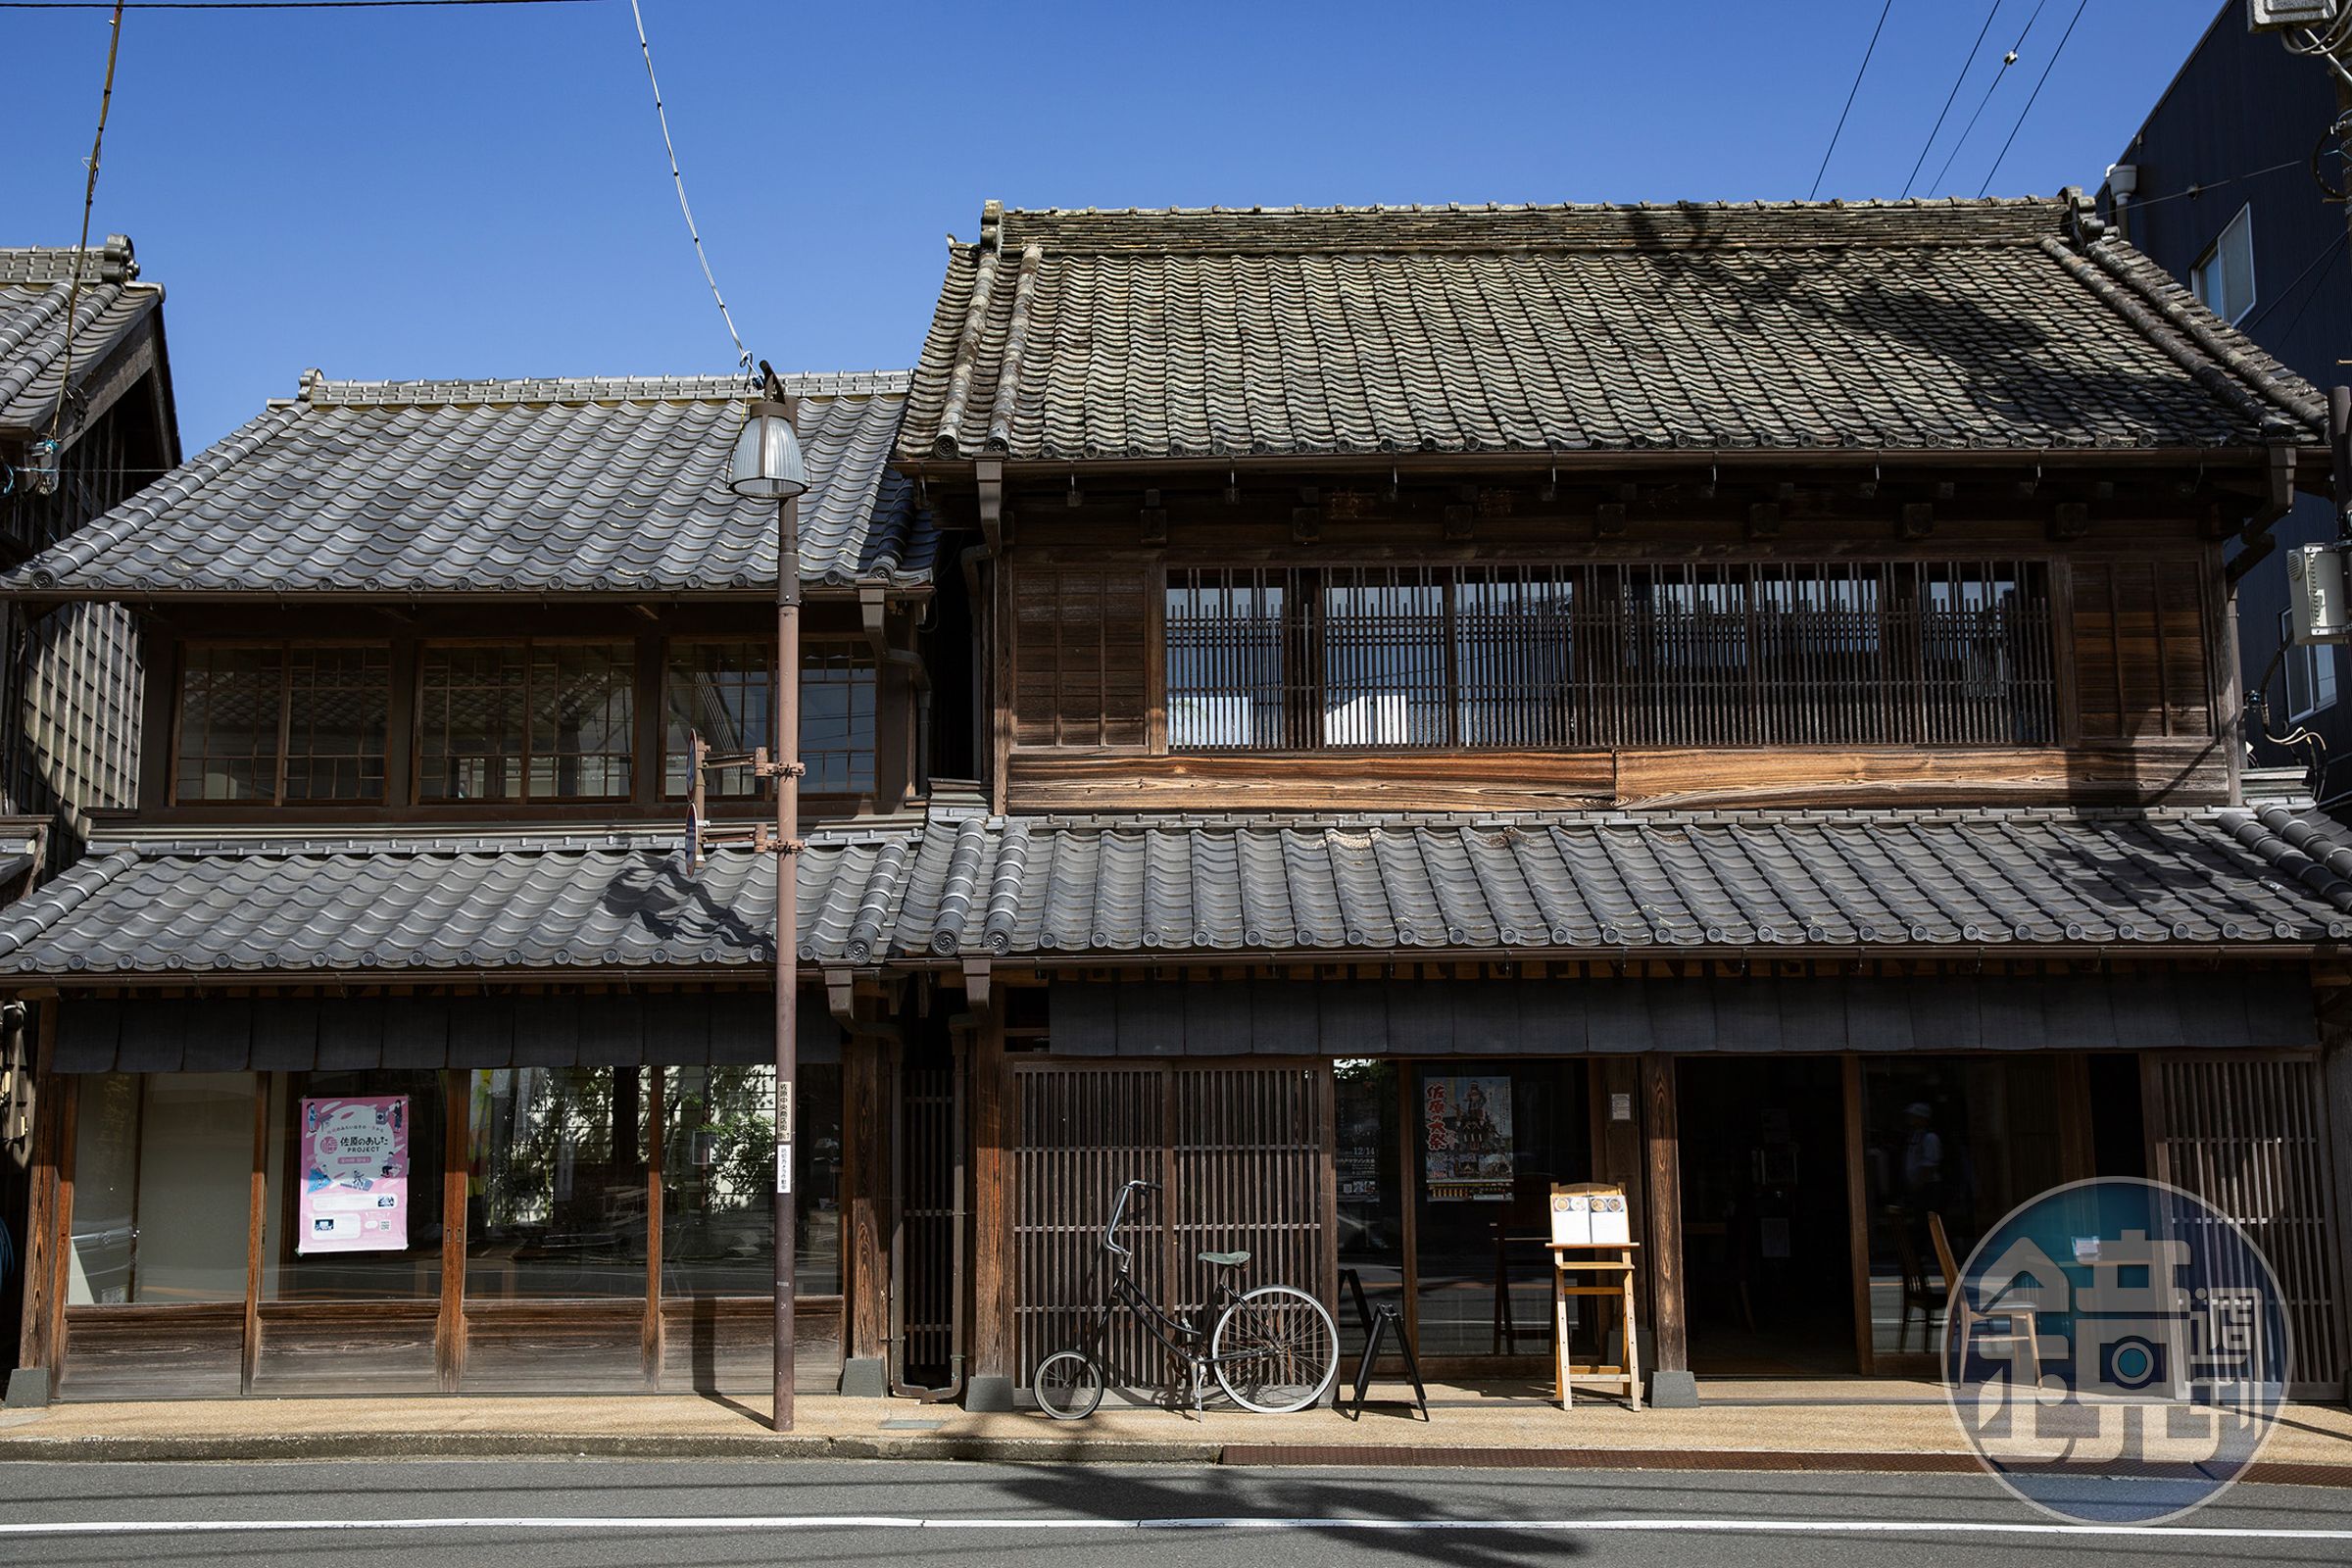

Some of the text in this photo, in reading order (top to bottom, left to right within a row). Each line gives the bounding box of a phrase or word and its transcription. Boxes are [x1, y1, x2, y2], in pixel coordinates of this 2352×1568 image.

[1426, 1084, 1446, 1150] 佐原の大祭
[340, 1136, 389, 1147] 佐原のあした
